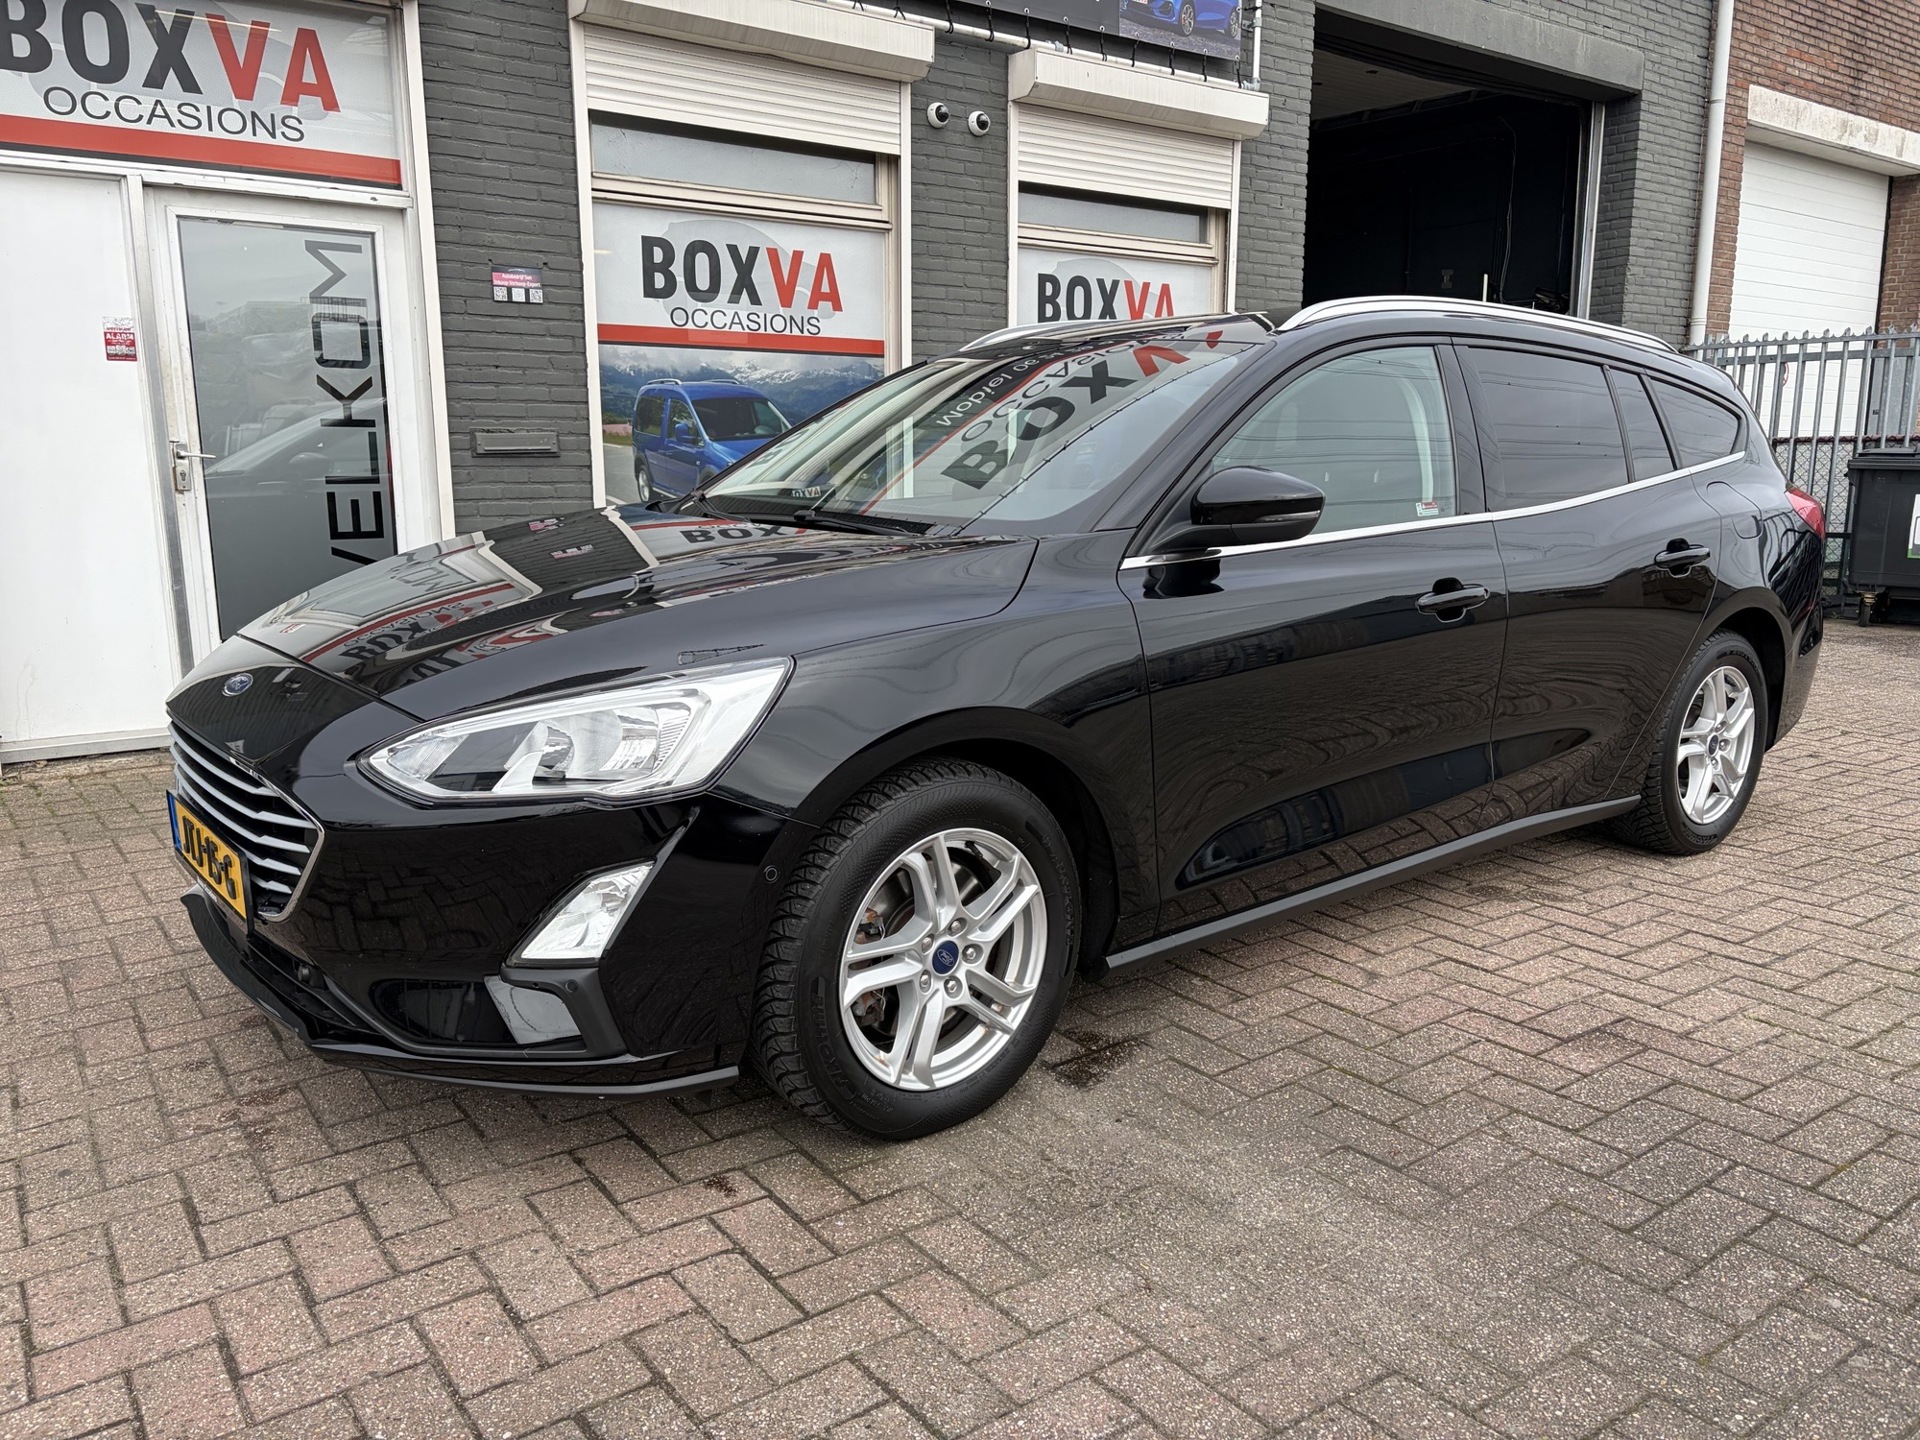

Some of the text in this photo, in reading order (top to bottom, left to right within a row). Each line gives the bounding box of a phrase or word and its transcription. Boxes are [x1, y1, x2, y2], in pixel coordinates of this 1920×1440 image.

[0, 0, 341, 113] BOXVA
[43, 86, 305, 143] OCCASIONS
[641, 235, 844, 313] BOXVA
[1037, 272, 1175, 323] BOXVA
[670, 306, 821, 336] OCCASIONS
[304, 239, 385, 566] ELKOM
